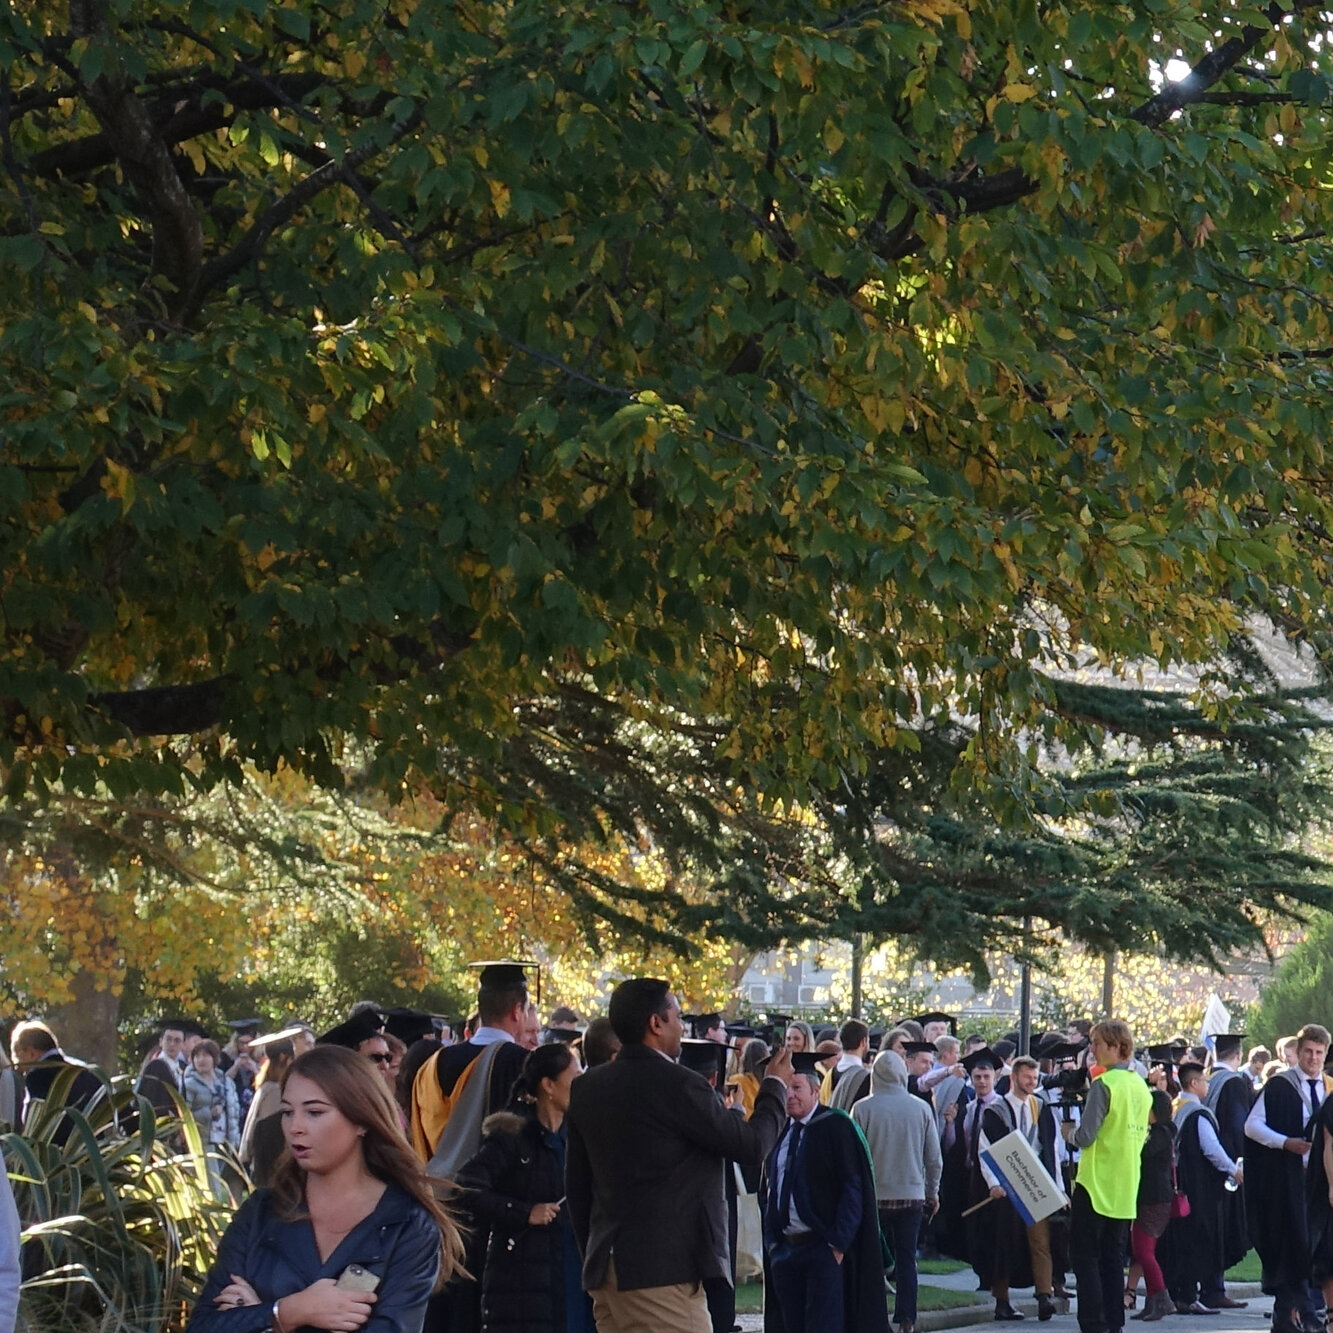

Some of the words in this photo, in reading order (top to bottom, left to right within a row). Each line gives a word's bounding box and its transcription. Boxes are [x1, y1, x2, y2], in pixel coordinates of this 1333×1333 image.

[1005, 1154, 1039, 1203] Commerce
[1011, 1150, 1039, 1188] Bachelor
[1037, 1189, 1047, 1200] of
